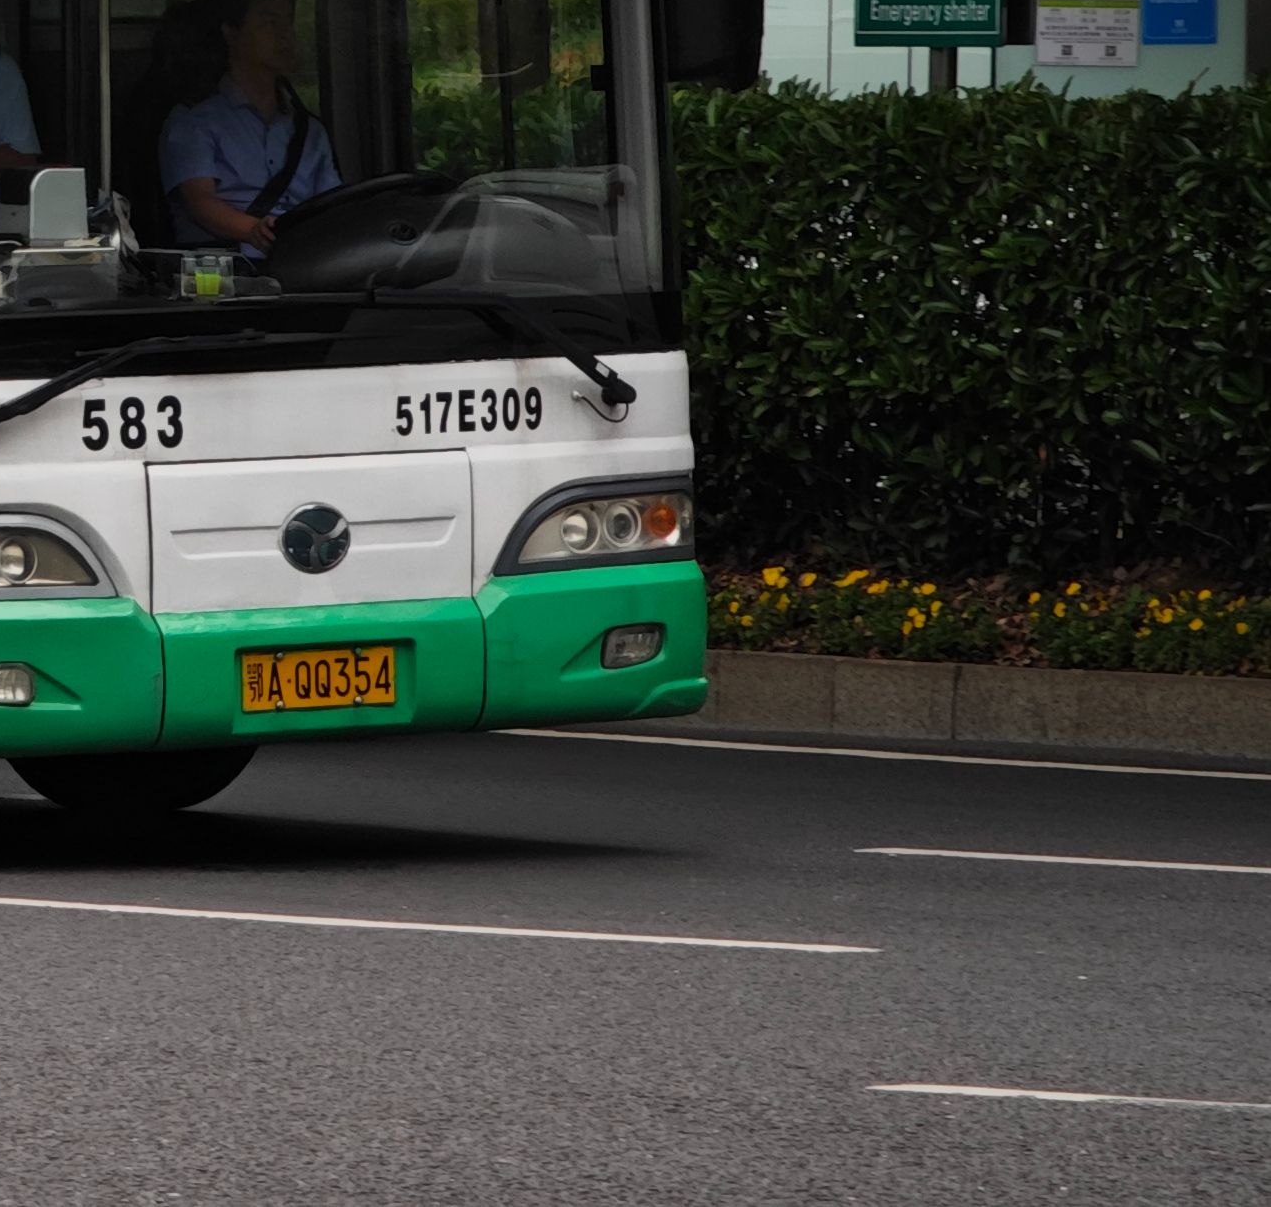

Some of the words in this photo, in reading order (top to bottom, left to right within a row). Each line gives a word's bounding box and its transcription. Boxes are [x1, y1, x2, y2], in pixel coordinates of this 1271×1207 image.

[870, 0, 942, 26] Emergency
[944, 0, 991, 22] shelter
[81, 394, 183, 451] 583
[395, 386, 543, 436] 517E309
